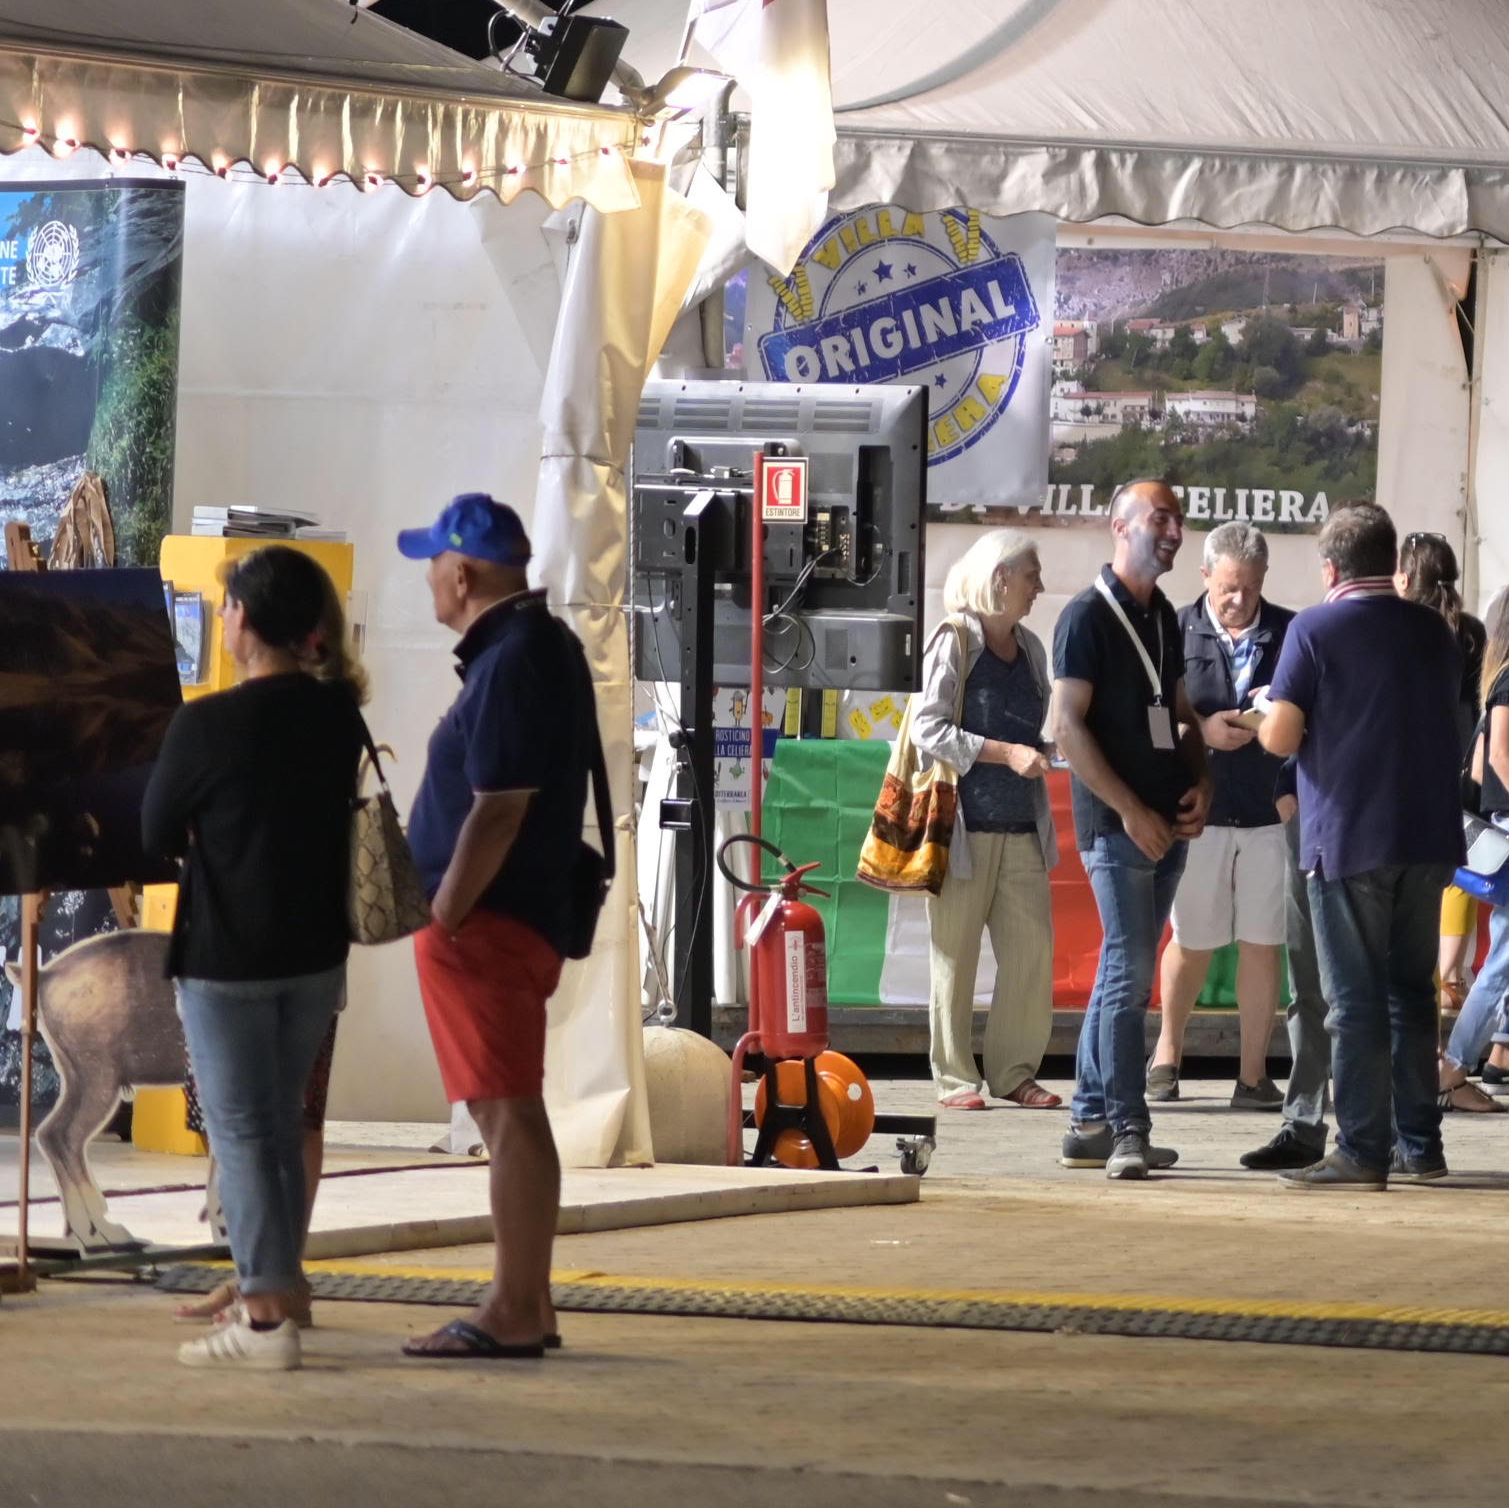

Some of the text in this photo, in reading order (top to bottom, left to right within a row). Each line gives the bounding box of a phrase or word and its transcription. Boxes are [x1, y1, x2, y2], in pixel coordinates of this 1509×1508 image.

[811, 209, 926, 271] VILLA
[784, 279, 1016, 384] ORIGINAL
[766, 507, 800, 517] ESTINTORE
[716, 729, 750, 741] ROSTICINO
